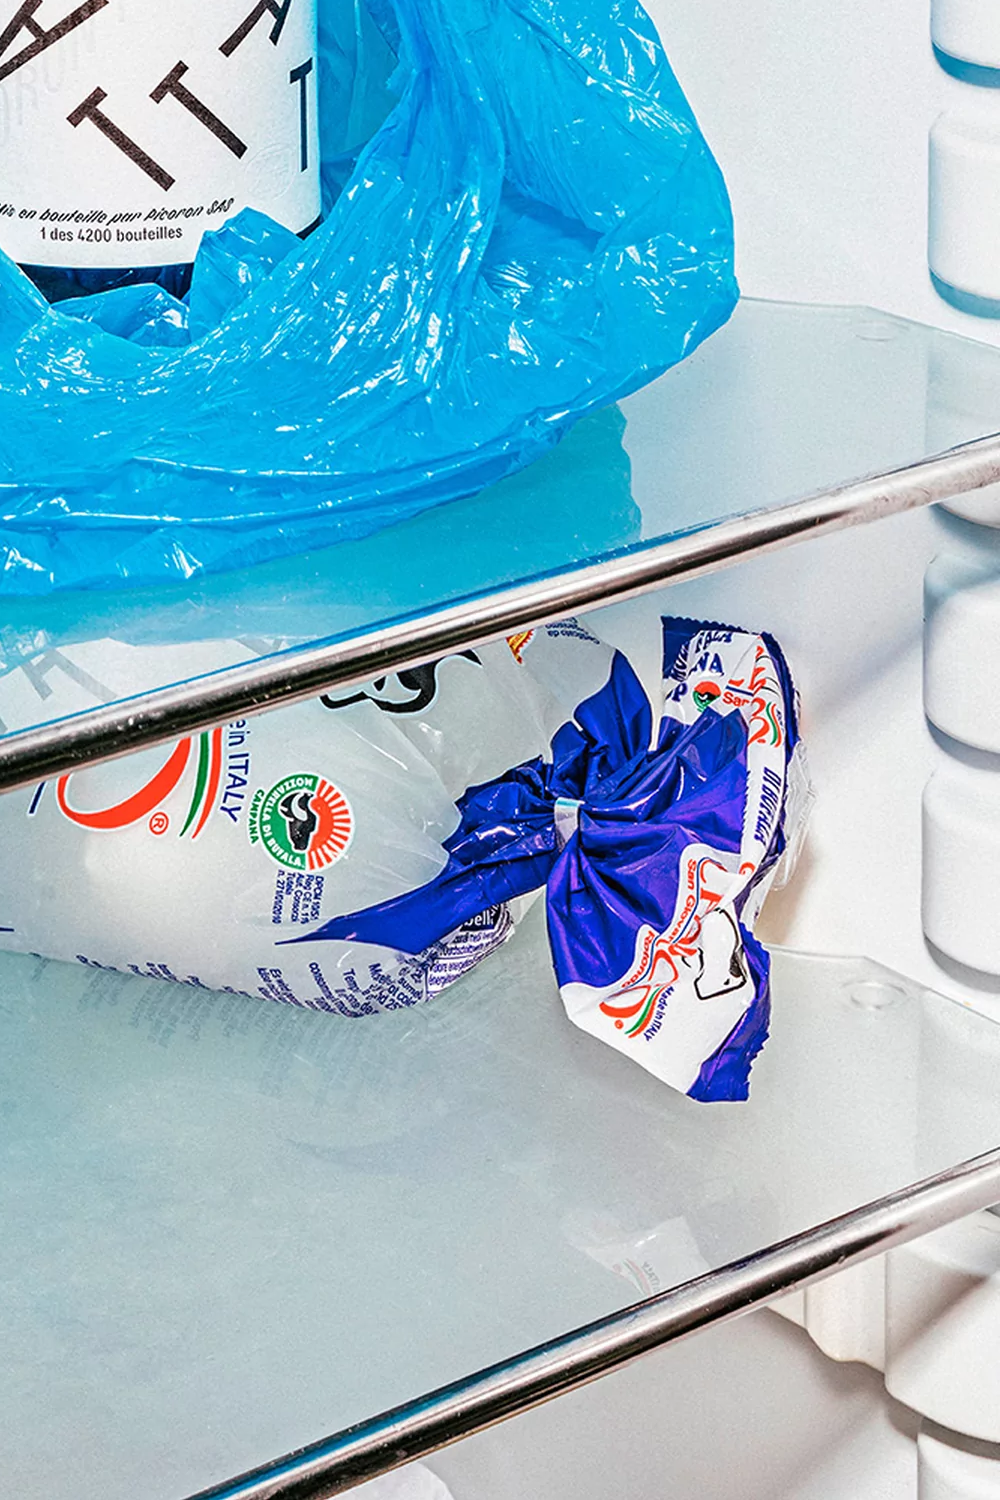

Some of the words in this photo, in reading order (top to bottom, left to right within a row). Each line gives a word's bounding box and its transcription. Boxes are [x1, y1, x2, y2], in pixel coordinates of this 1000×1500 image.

[18, 207, 37, 219] en
[39, 207, 108, 224] bouteille
[105, 211, 142, 226] par
[206, 197, 235, 216] SAS
[40, 227, 46, 240] 1
[50, 228, 74, 241] des
[77, 228, 112, 242] 4200
[116, 226, 183, 242] bouteilles
[228, 730, 250, 747] in
[220, 753, 249, 823] ITALY
[248, 789, 265, 844] CAMPANA
[262, 823, 273, 836] DI
[687, 858, 697, 890] San
[657, 985, 675, 1010] Made
[643, 1019, 663, 1042] ITALY
